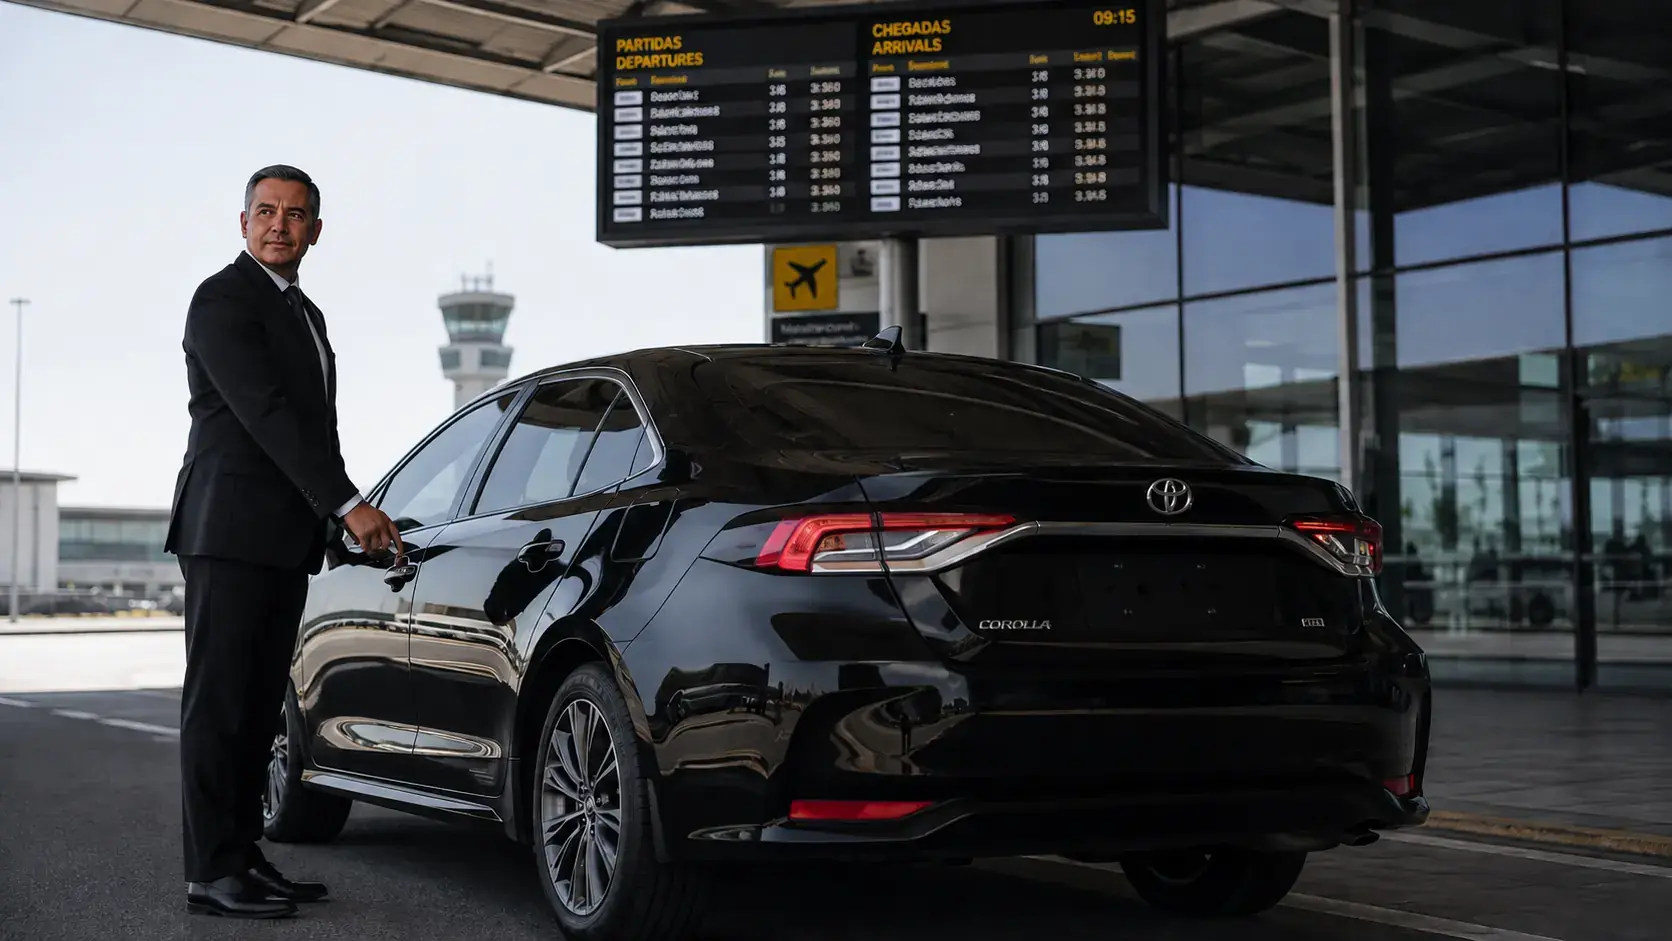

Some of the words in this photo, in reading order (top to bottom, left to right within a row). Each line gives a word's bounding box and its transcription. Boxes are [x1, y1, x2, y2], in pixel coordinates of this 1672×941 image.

[1093, 9, 1136, 25] 09:15
[872, 20, 951, 38] CHEGADAS
[616, 36, 682, 52] PARTIDAS
[872, 38, 942, 55] ARRIVALS
[616, 52, 704, 70] DEPARTURES
[979, 620, 1052, 630] COROLLA
